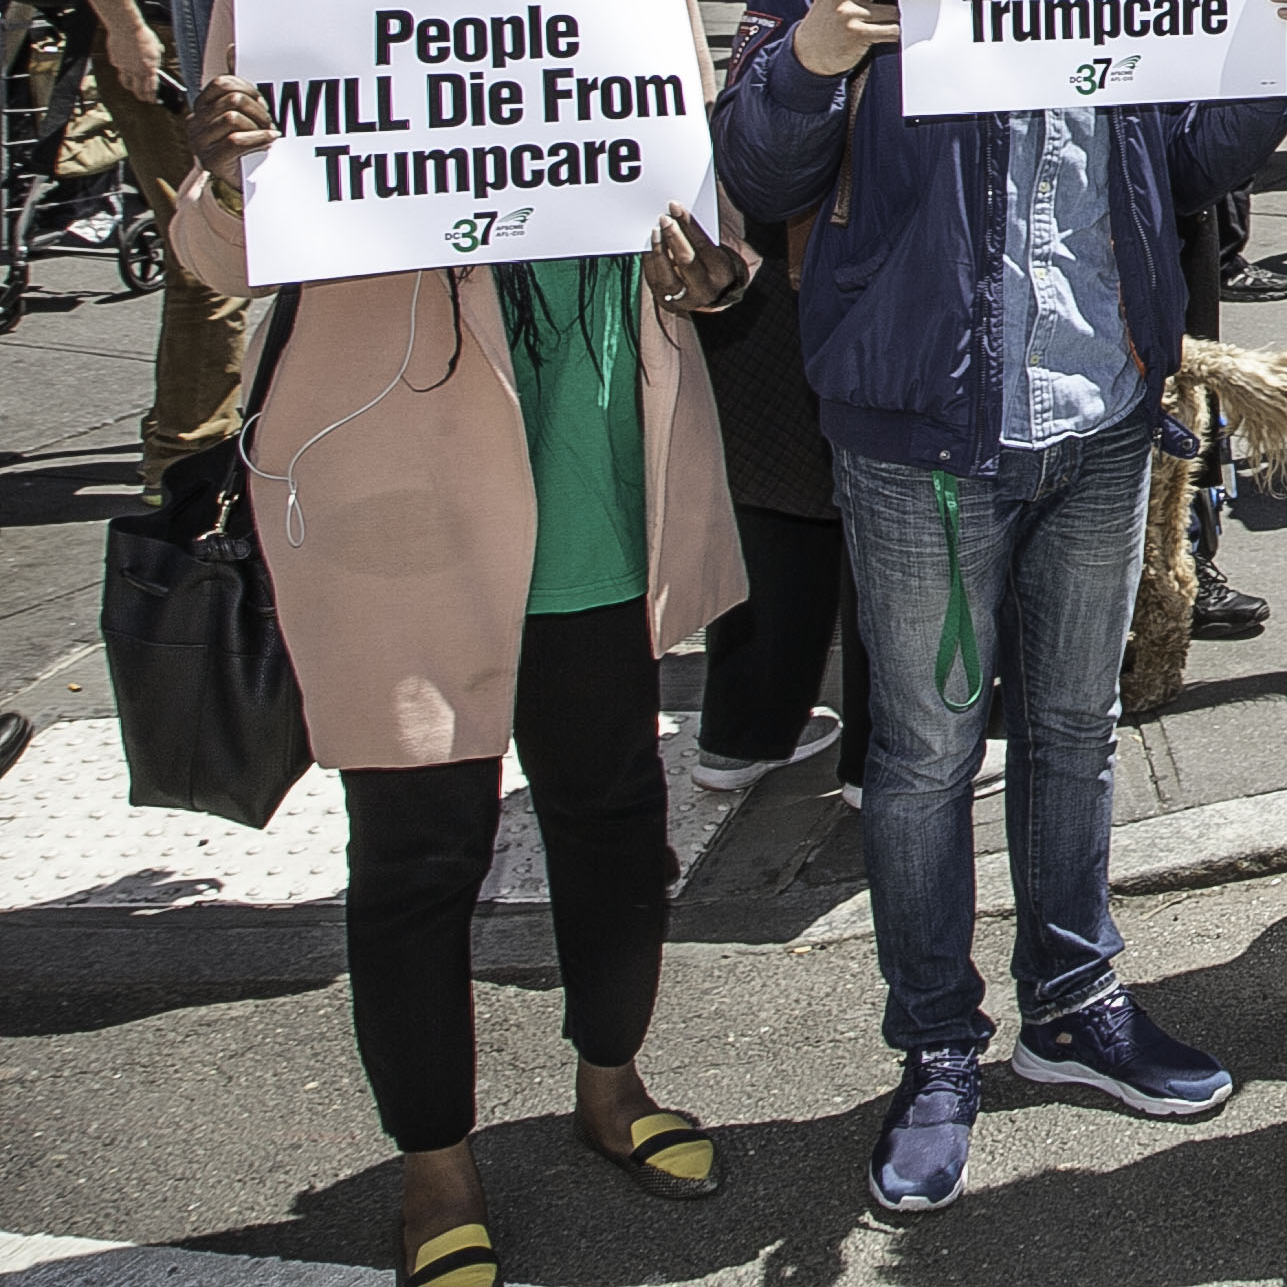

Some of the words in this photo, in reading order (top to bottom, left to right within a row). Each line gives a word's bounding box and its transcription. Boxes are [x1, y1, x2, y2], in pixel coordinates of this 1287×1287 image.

[374, 4, 580, 69] People
[257, 75, 411, 139] WILL
[427, 71, 525, 130] Die
[542, 67, 686, 124] From
[315, 138, 642, 202] Trumpcare
